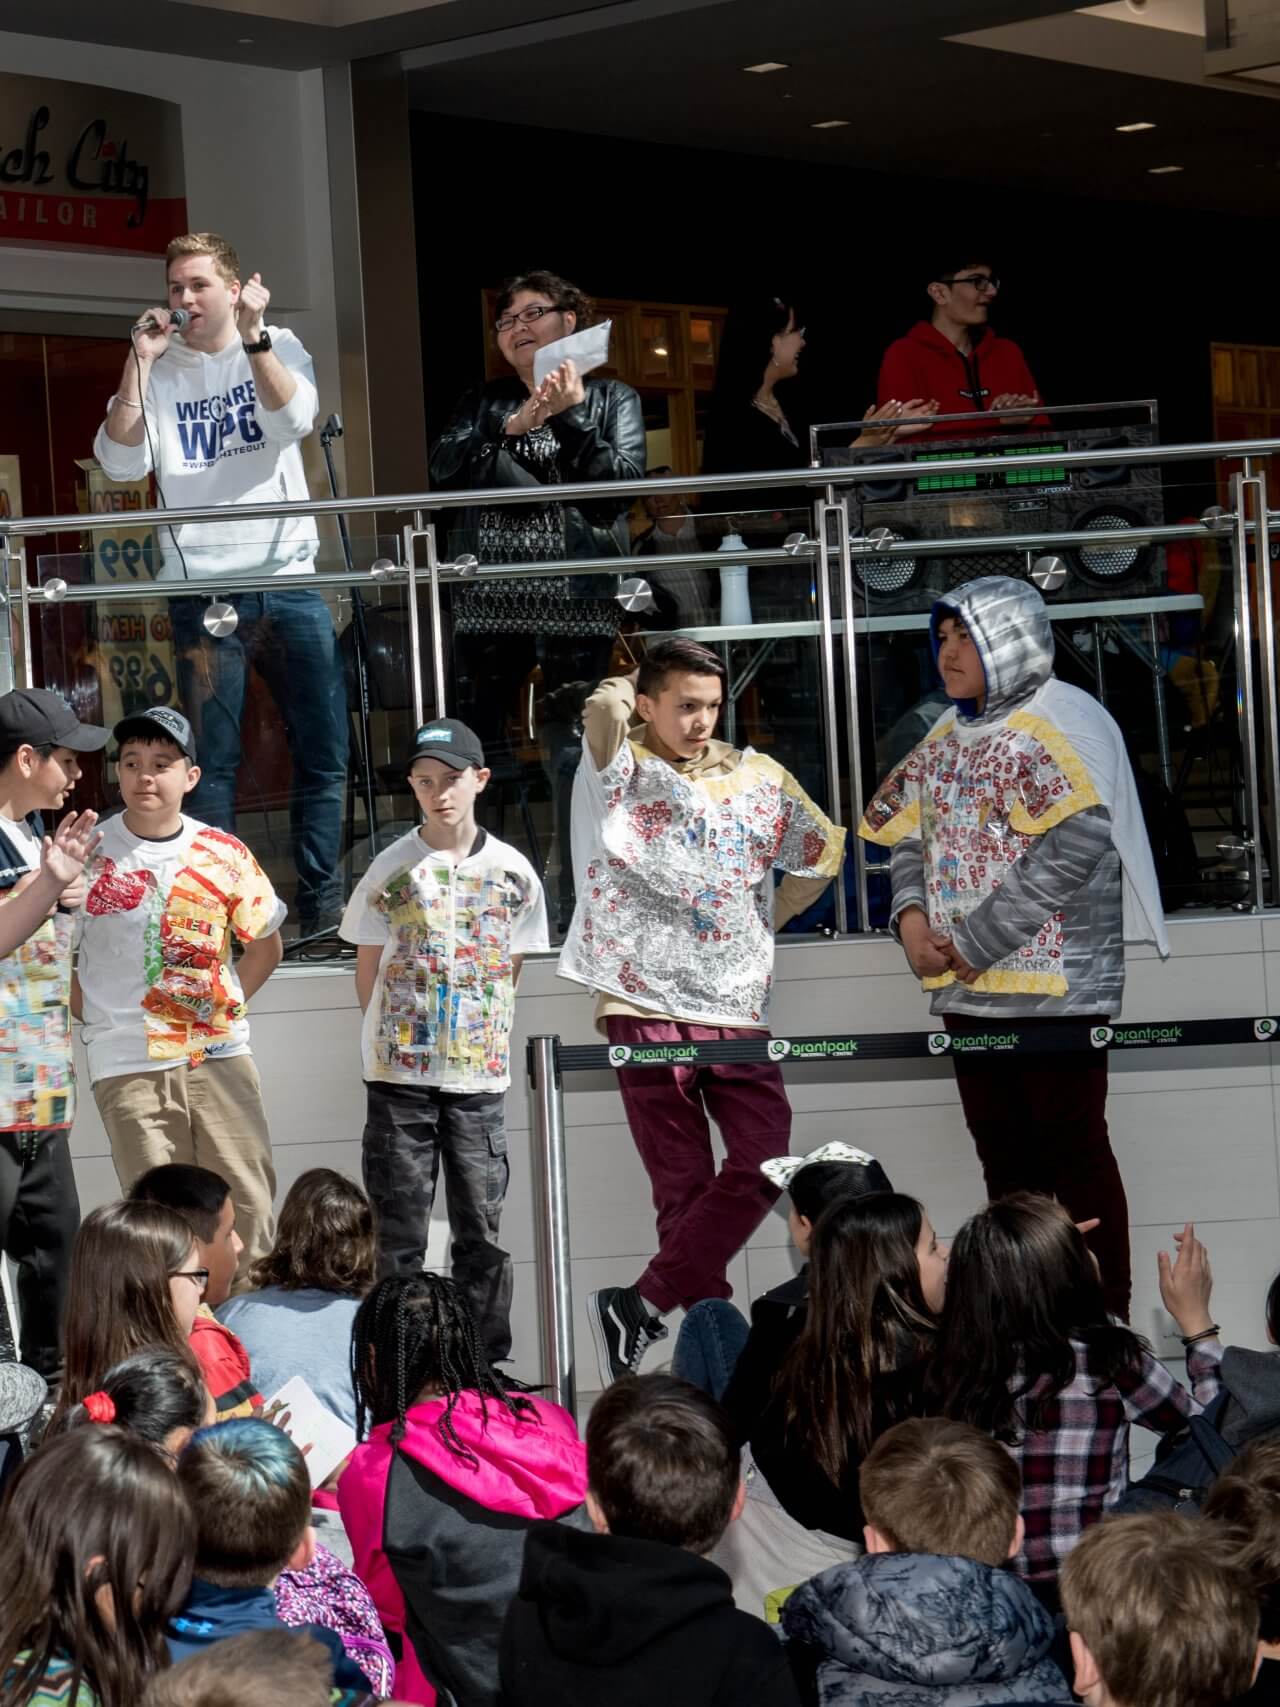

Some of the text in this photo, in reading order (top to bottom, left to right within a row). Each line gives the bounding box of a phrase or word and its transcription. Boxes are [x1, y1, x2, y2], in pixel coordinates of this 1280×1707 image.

[67, 119, 150, 229] City
[176, 398, 211, 421] WE
[177, 403, 263, 460] WPG
[182, 441, 267, 468] #WPGHITEOUT
[952, 1033, 1020, 1050] grantpark
[1114, 1026, 1183, 1043] grantpark
[632, 1045, 699, 1061] grantpark
[791, 1039, 858, 1056] grantpark
